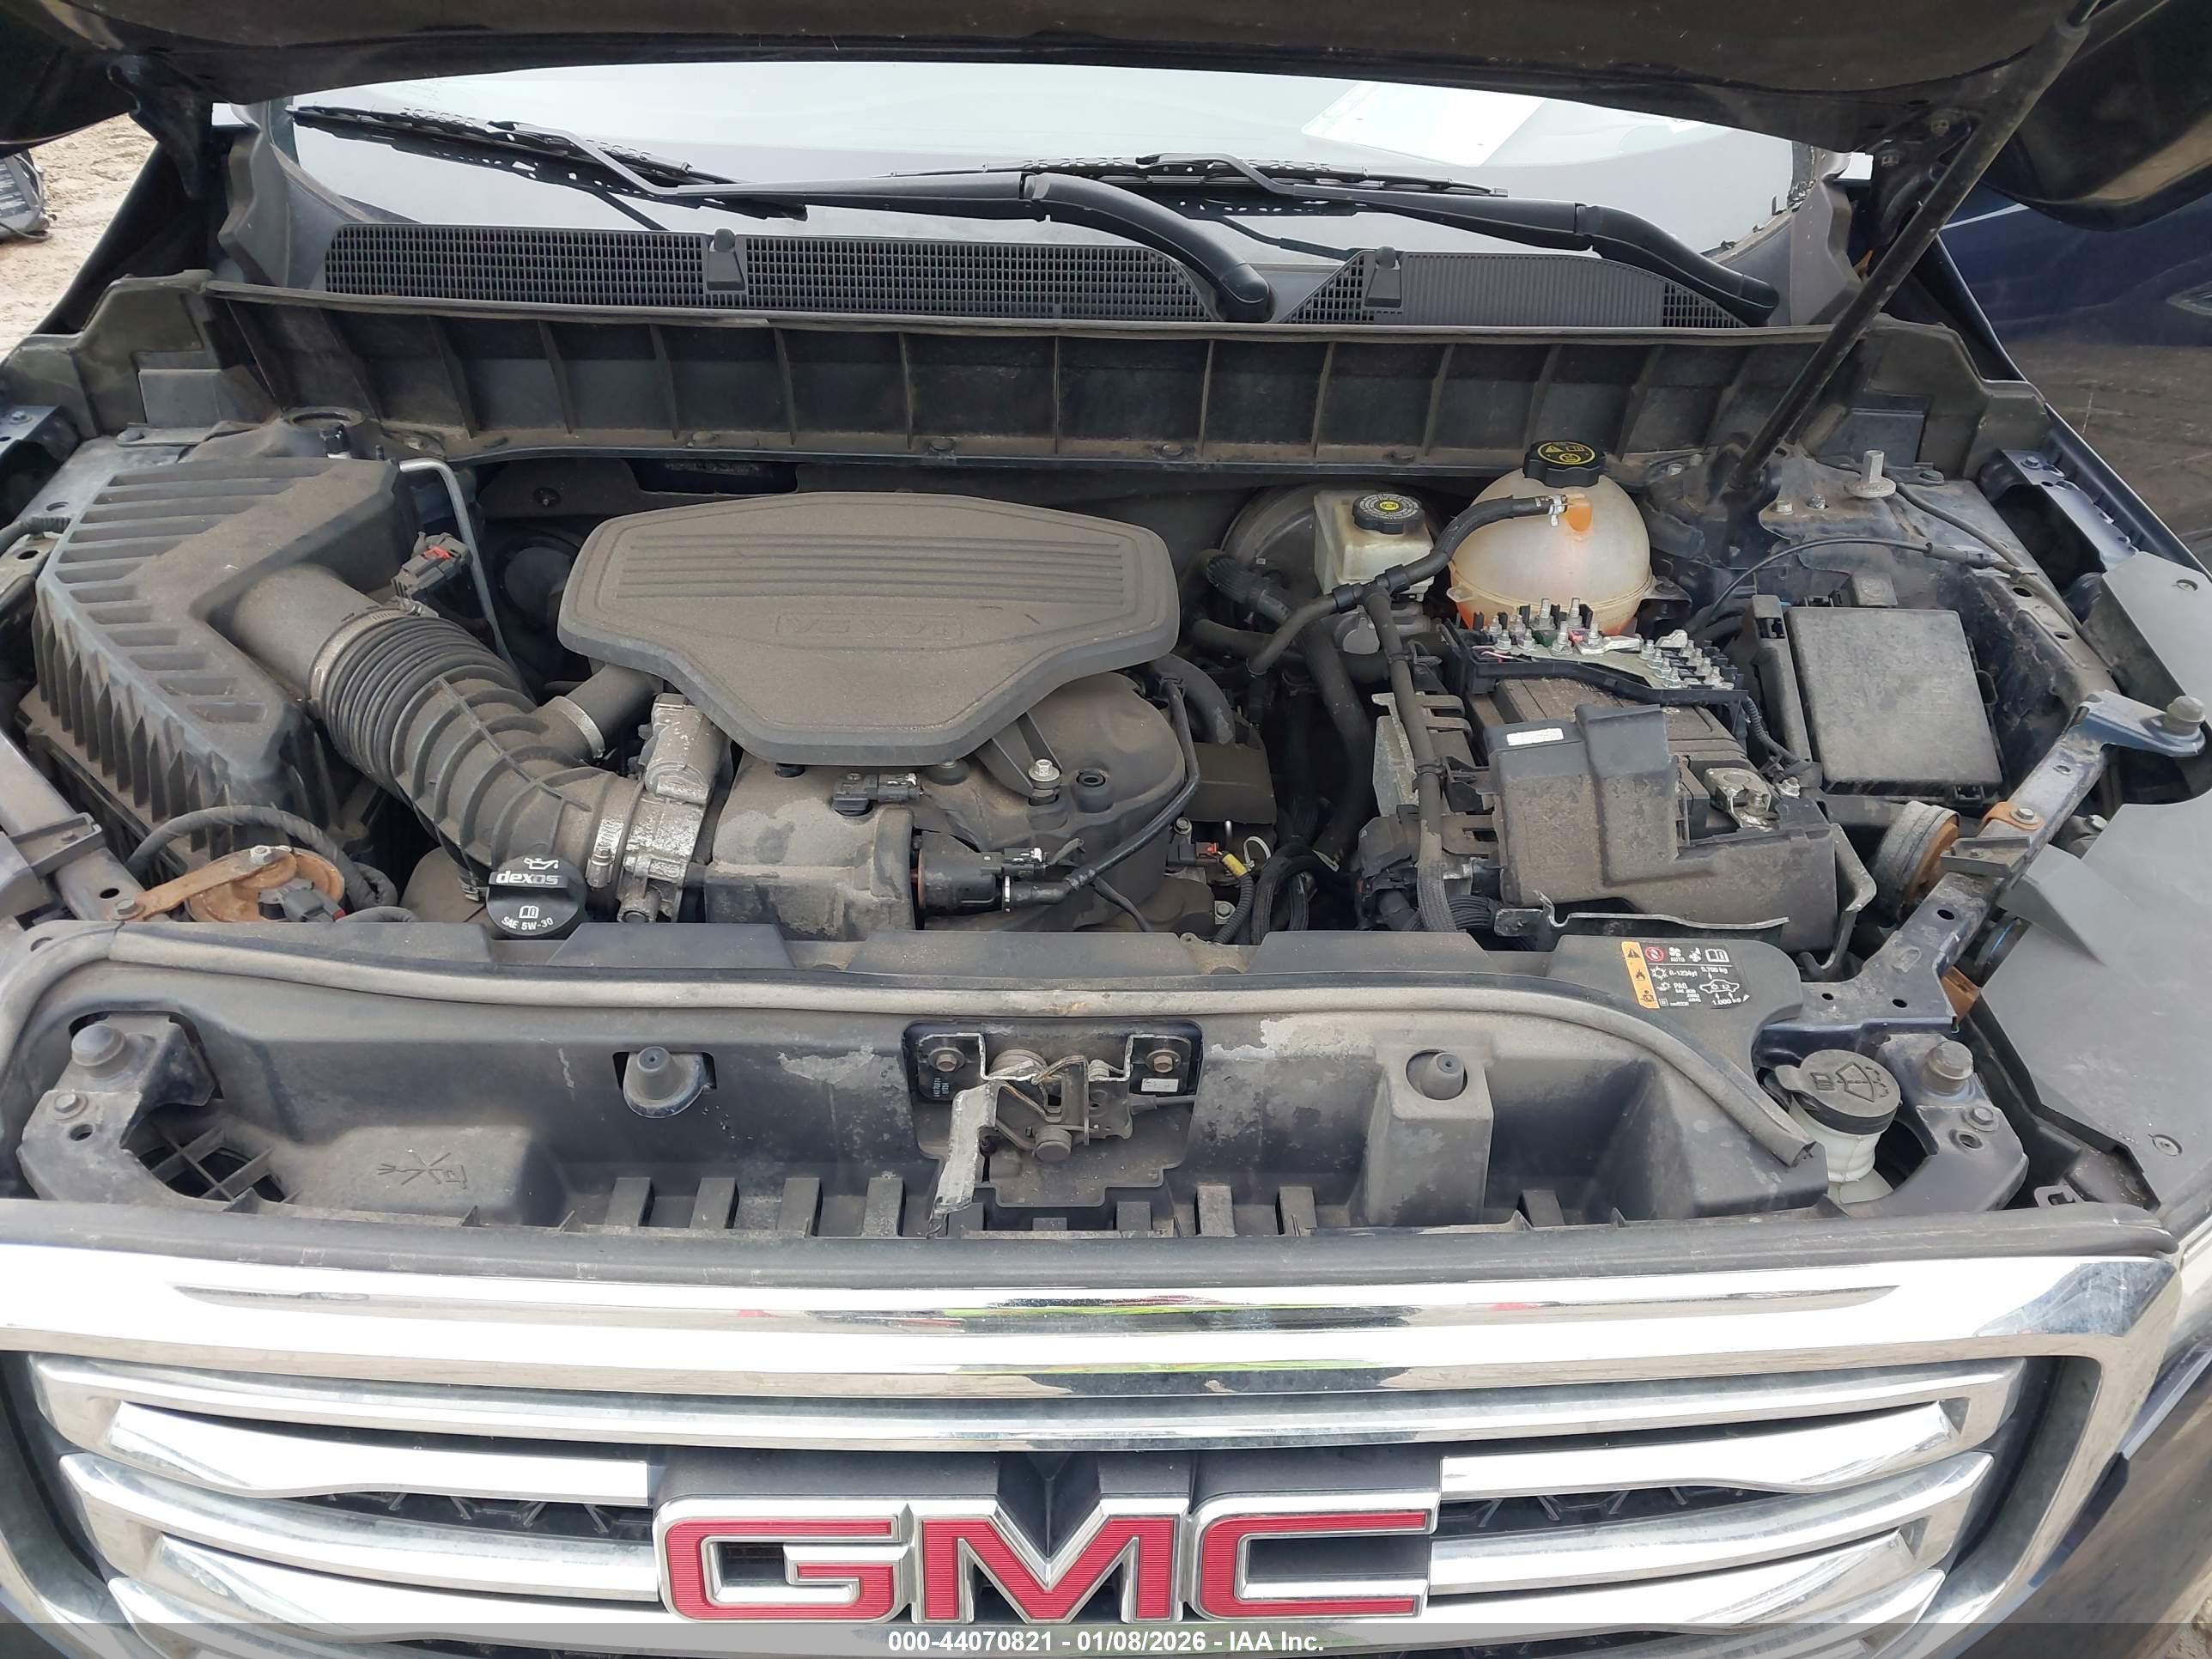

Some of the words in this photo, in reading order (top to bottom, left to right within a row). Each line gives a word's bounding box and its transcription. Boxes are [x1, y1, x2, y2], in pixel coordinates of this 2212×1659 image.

[495, 870, 561, 885] dexos
[501, 915, 520, 930] SAE
[520, 916, 554, 931] 5W-30
[658, 1494, 1438, 1624] GMC
